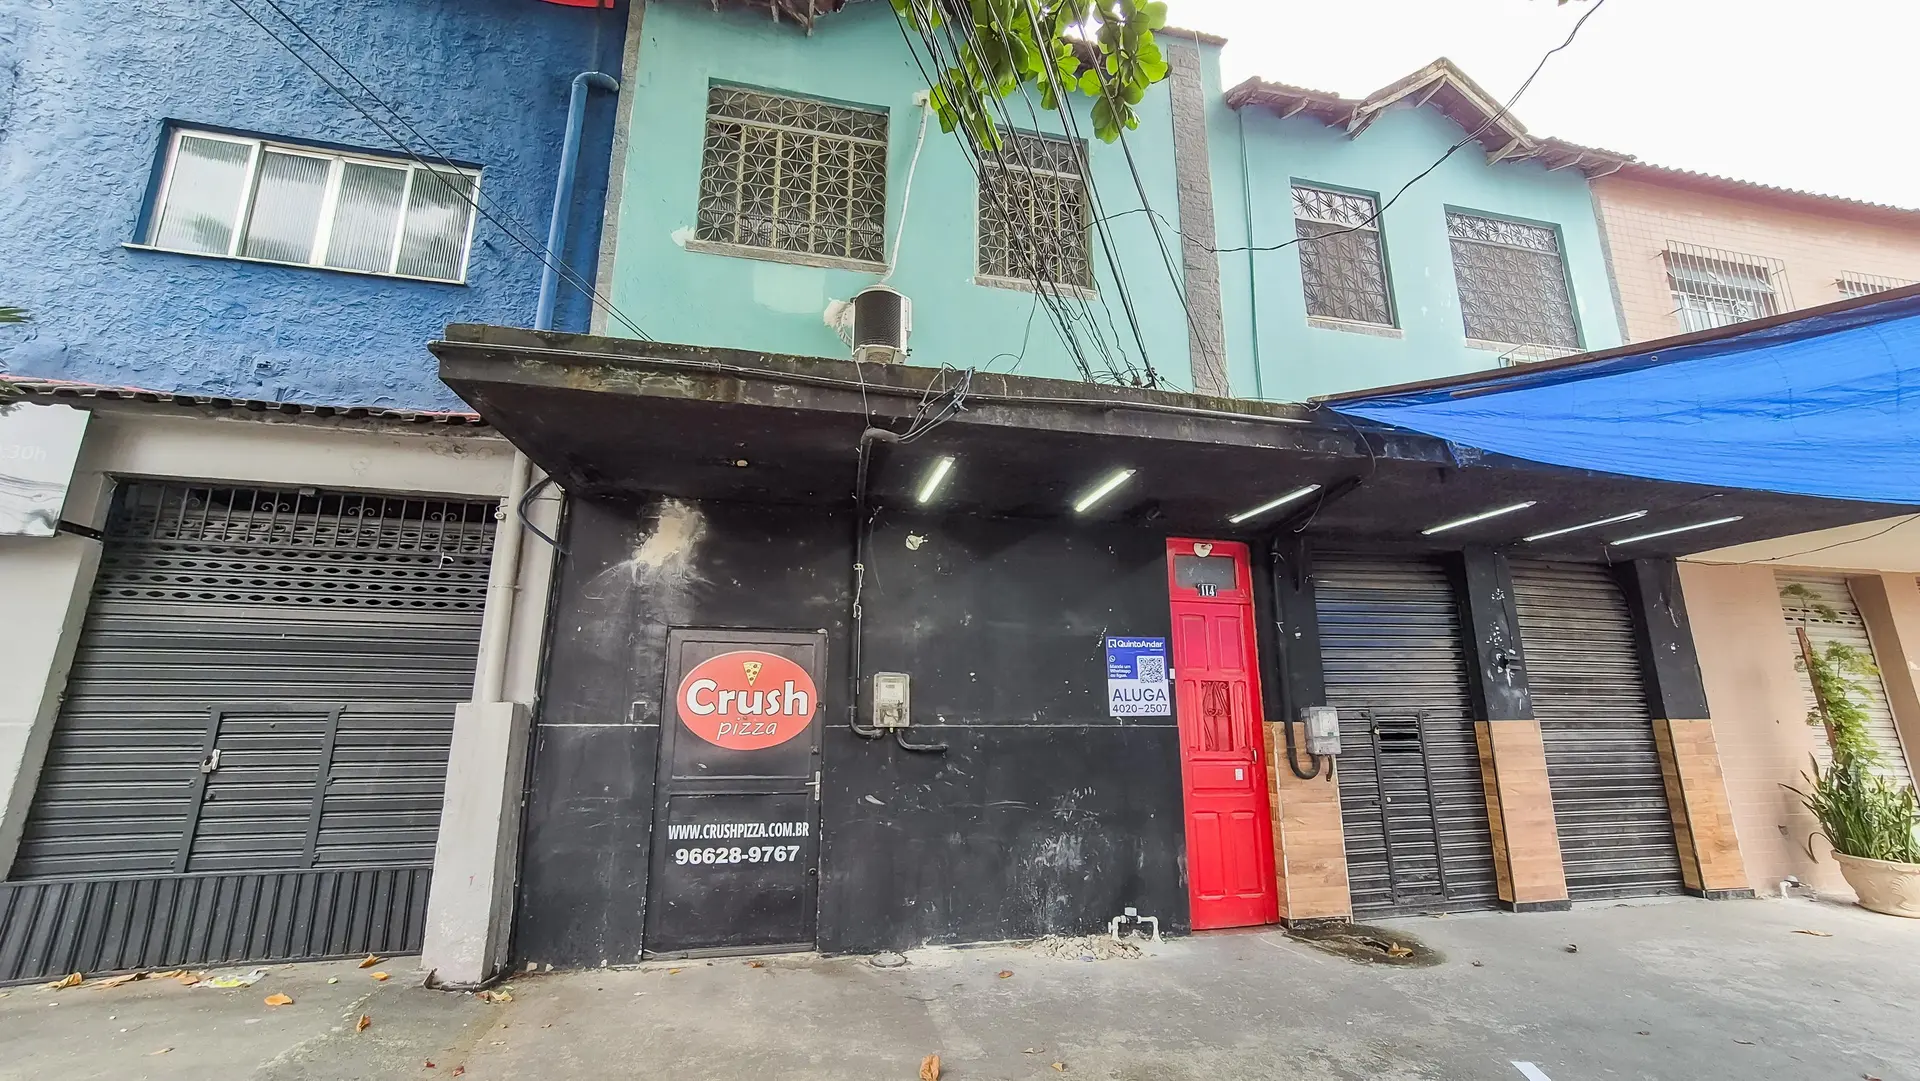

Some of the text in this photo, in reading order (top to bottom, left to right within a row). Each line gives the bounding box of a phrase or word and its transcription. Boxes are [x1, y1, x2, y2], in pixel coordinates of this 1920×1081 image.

[1201, 585, 1215, 596] 114
[1117, 640, 1163, 648] QuintoAndar
[686, 678, 809, 716] Crush
[1112, 688, 1167, 702] ALUGA
[1112, 703, 1168, 713] 4020-2507
[716, 718, 777, 741] pizza
[668, 822, 810, 840] WWW.CRUSHPIZZA.COM.BR
[675, 846, 800, 865] 96628-9767
